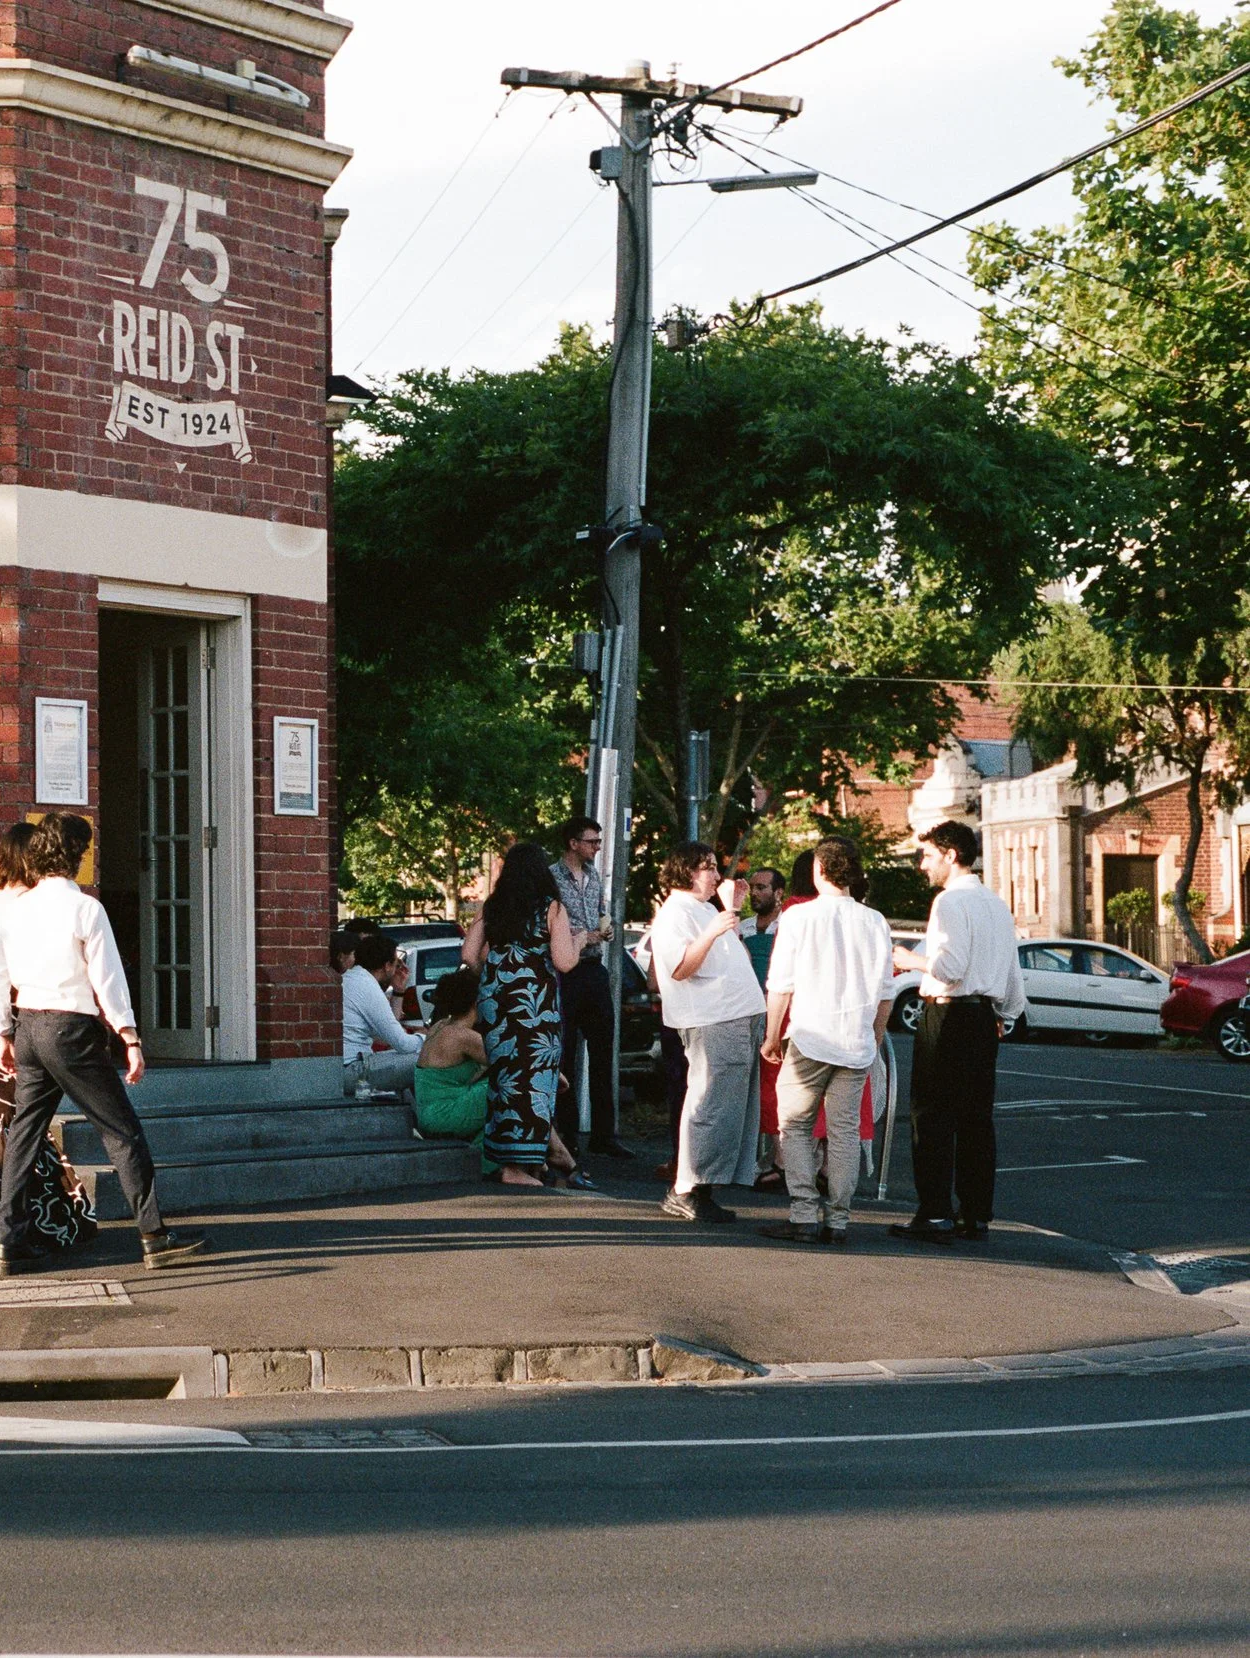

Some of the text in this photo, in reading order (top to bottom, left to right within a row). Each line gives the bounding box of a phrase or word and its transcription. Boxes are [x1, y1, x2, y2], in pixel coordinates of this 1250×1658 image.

[134, 176, 230, 302] 75
[113, 300, 245, 395] REID ST
[128, 395, 231, 436] EST 1924
